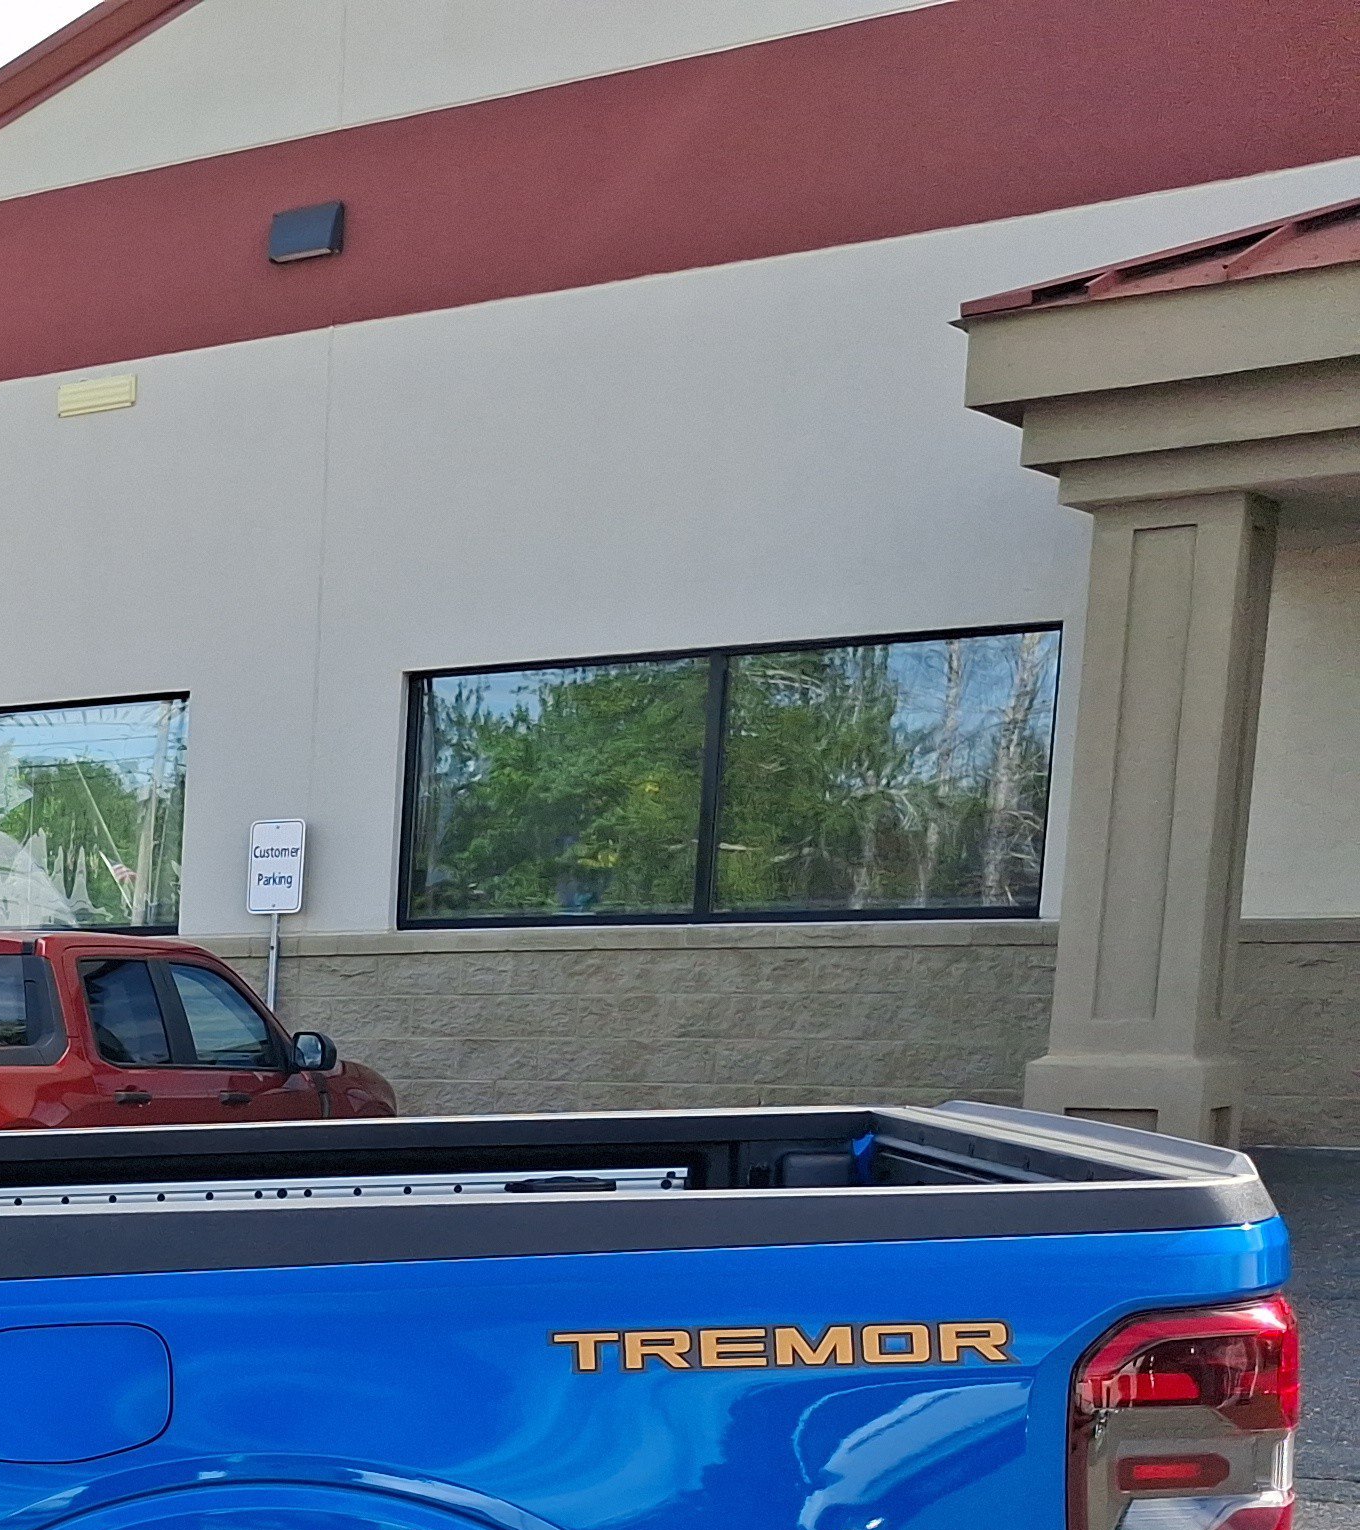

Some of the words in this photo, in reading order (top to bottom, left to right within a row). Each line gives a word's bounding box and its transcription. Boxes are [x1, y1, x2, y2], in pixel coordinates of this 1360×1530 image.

[253, 846, 300, 859] Customer
[257, 872, 293, 888] Parking
[551, 1320, 1013, 1373] TREMOR
